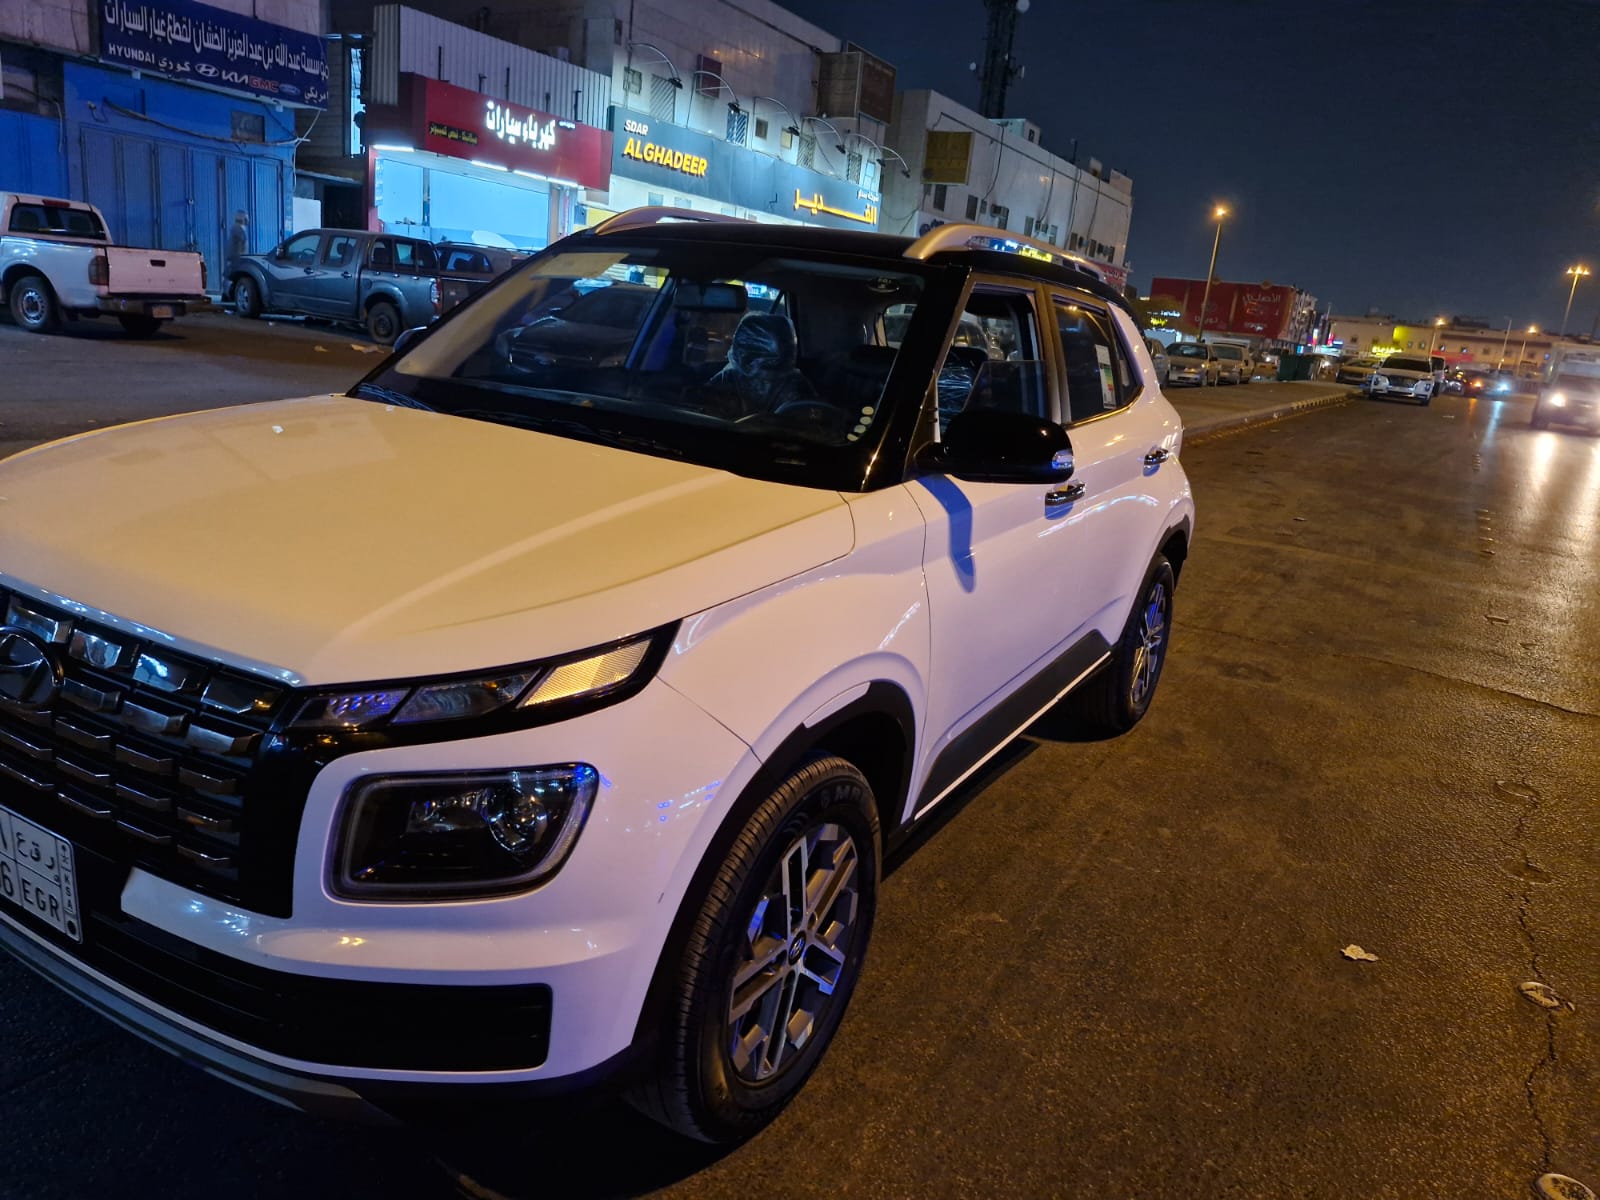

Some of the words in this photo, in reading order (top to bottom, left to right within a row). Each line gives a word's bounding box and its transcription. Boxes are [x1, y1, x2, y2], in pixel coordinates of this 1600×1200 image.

[104, 0, 148, 36] السيارات
[149, 8, 166, 42] غيار
[167, 12, 192, 45] لقطع
[108, 43, 155, 65] HYUNDAI
[249, 76, 279, 92] GMC
[486, 100, 521, 144] سيارات
[522, 113, 556, 150] كهرباء
[624, 119, 648, 136] SDAR
[624, 137, 708, 176] ALGHADEER
[794, 188, 877, 225] الغدير
[22, 877, 61, 922] EGR
